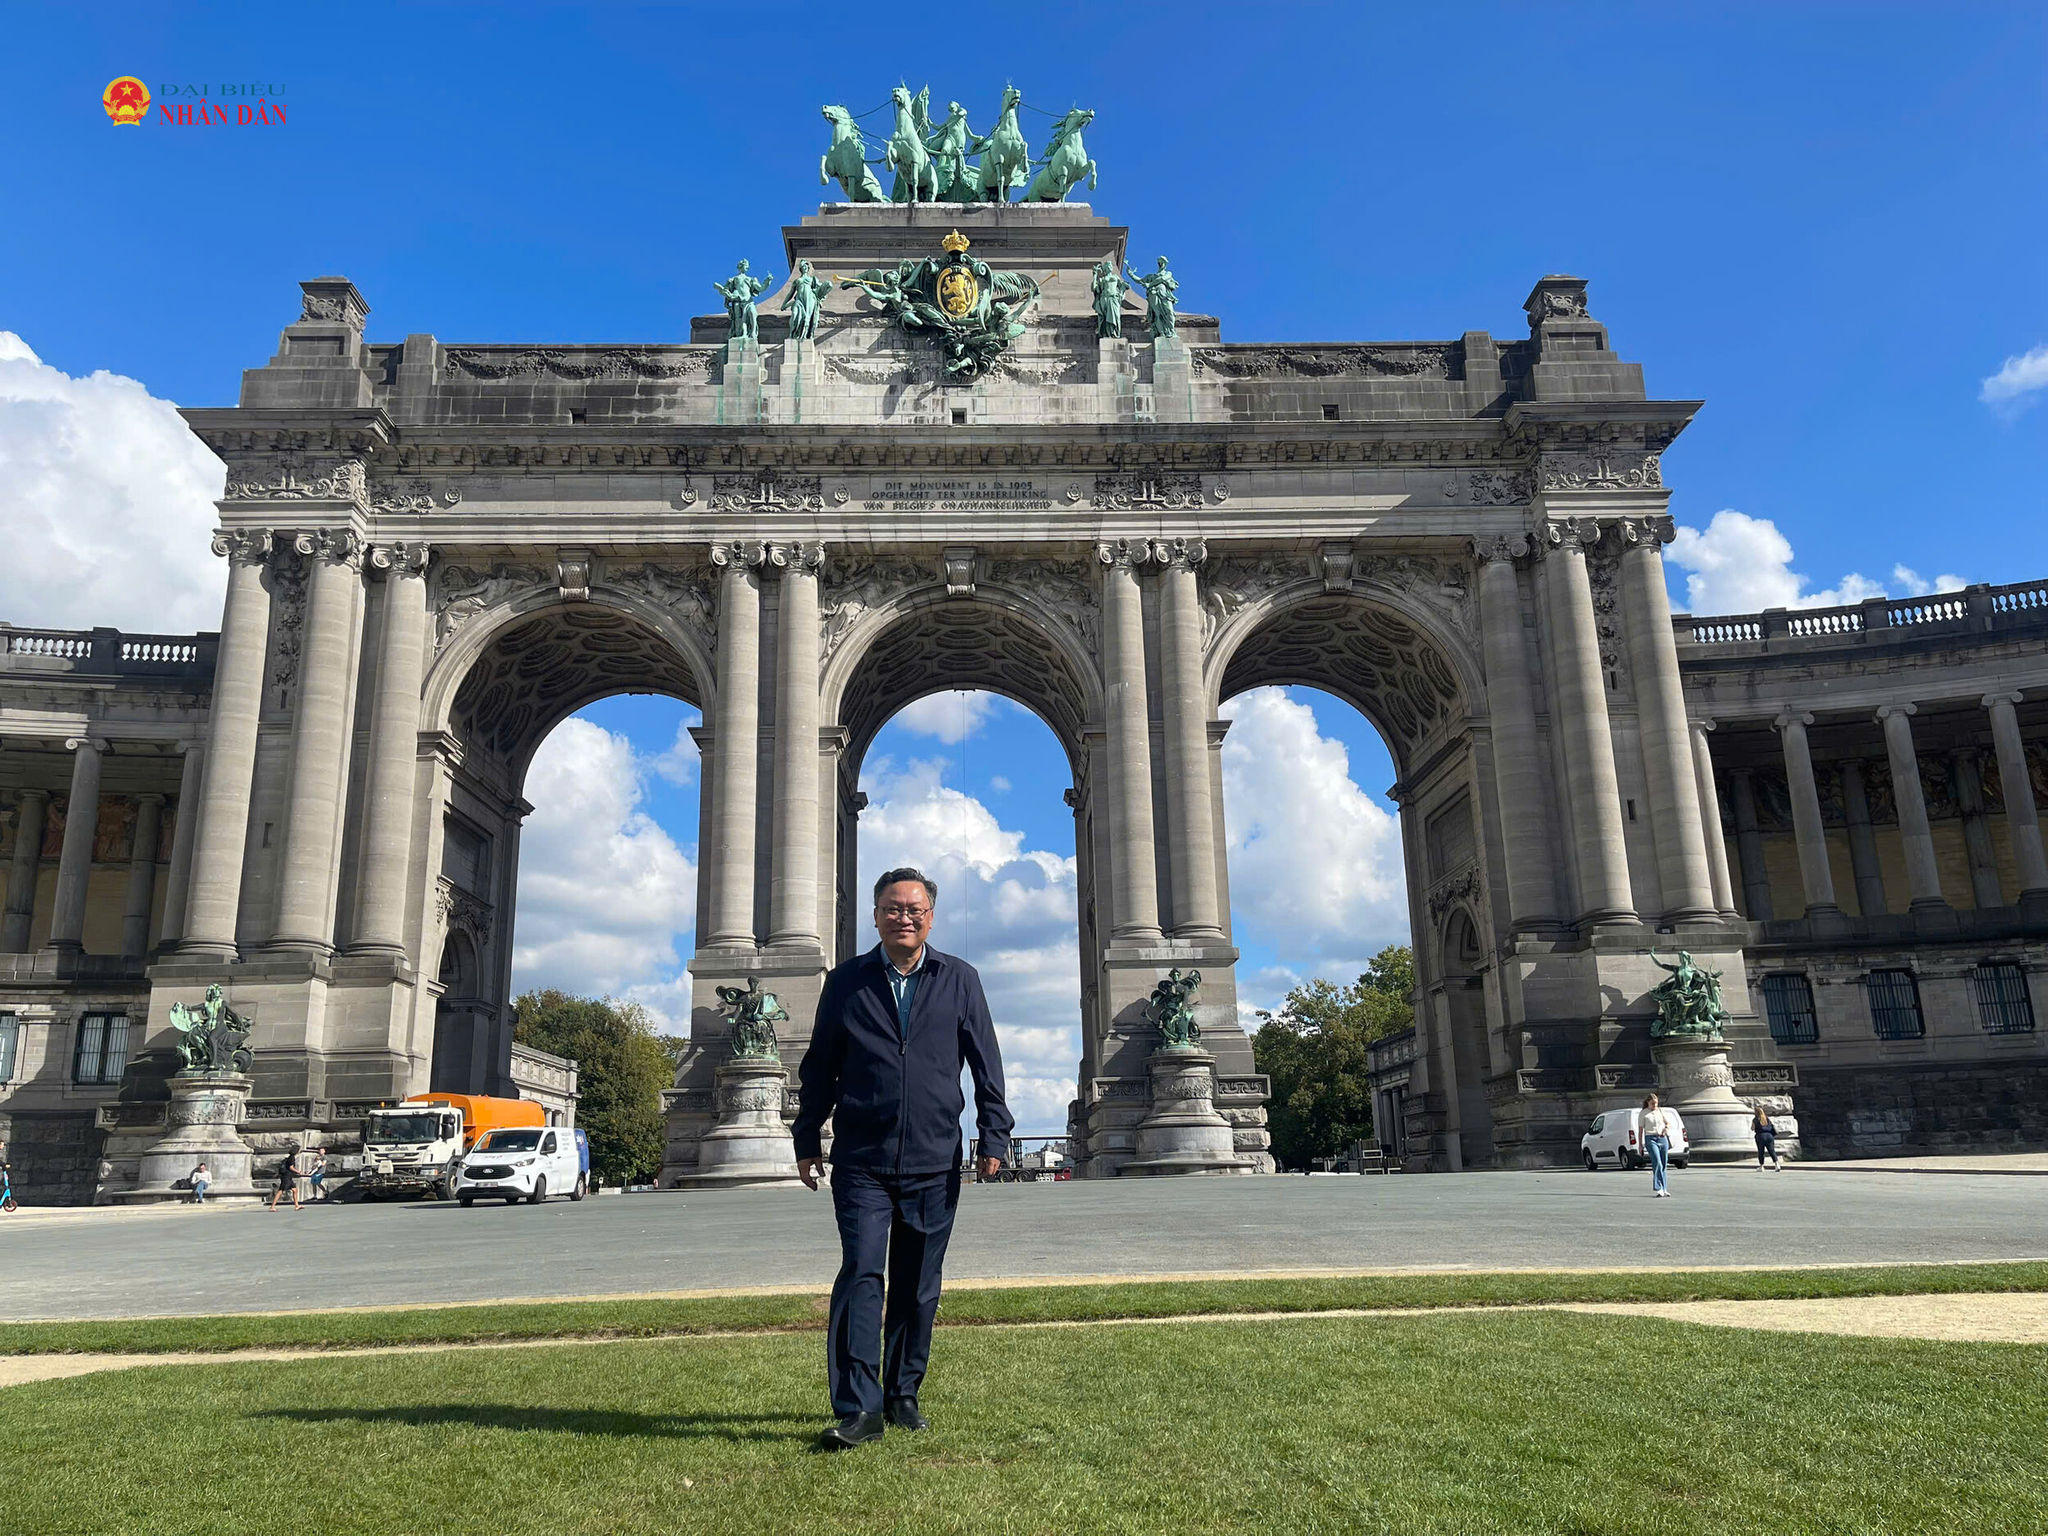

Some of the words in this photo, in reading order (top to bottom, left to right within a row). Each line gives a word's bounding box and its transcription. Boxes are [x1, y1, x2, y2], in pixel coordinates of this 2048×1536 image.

[885, 482, 903, 491] DIT
[909, 482, 971, 491] MONUMENT
[977, 481, 988, 490] IS
[1009, 481, 1033, 491] 1905
[871, 491, 930, 500] OPGERICHT
[938, 491, 956, 499] TER
[863, 501, 885, 511] VAN
